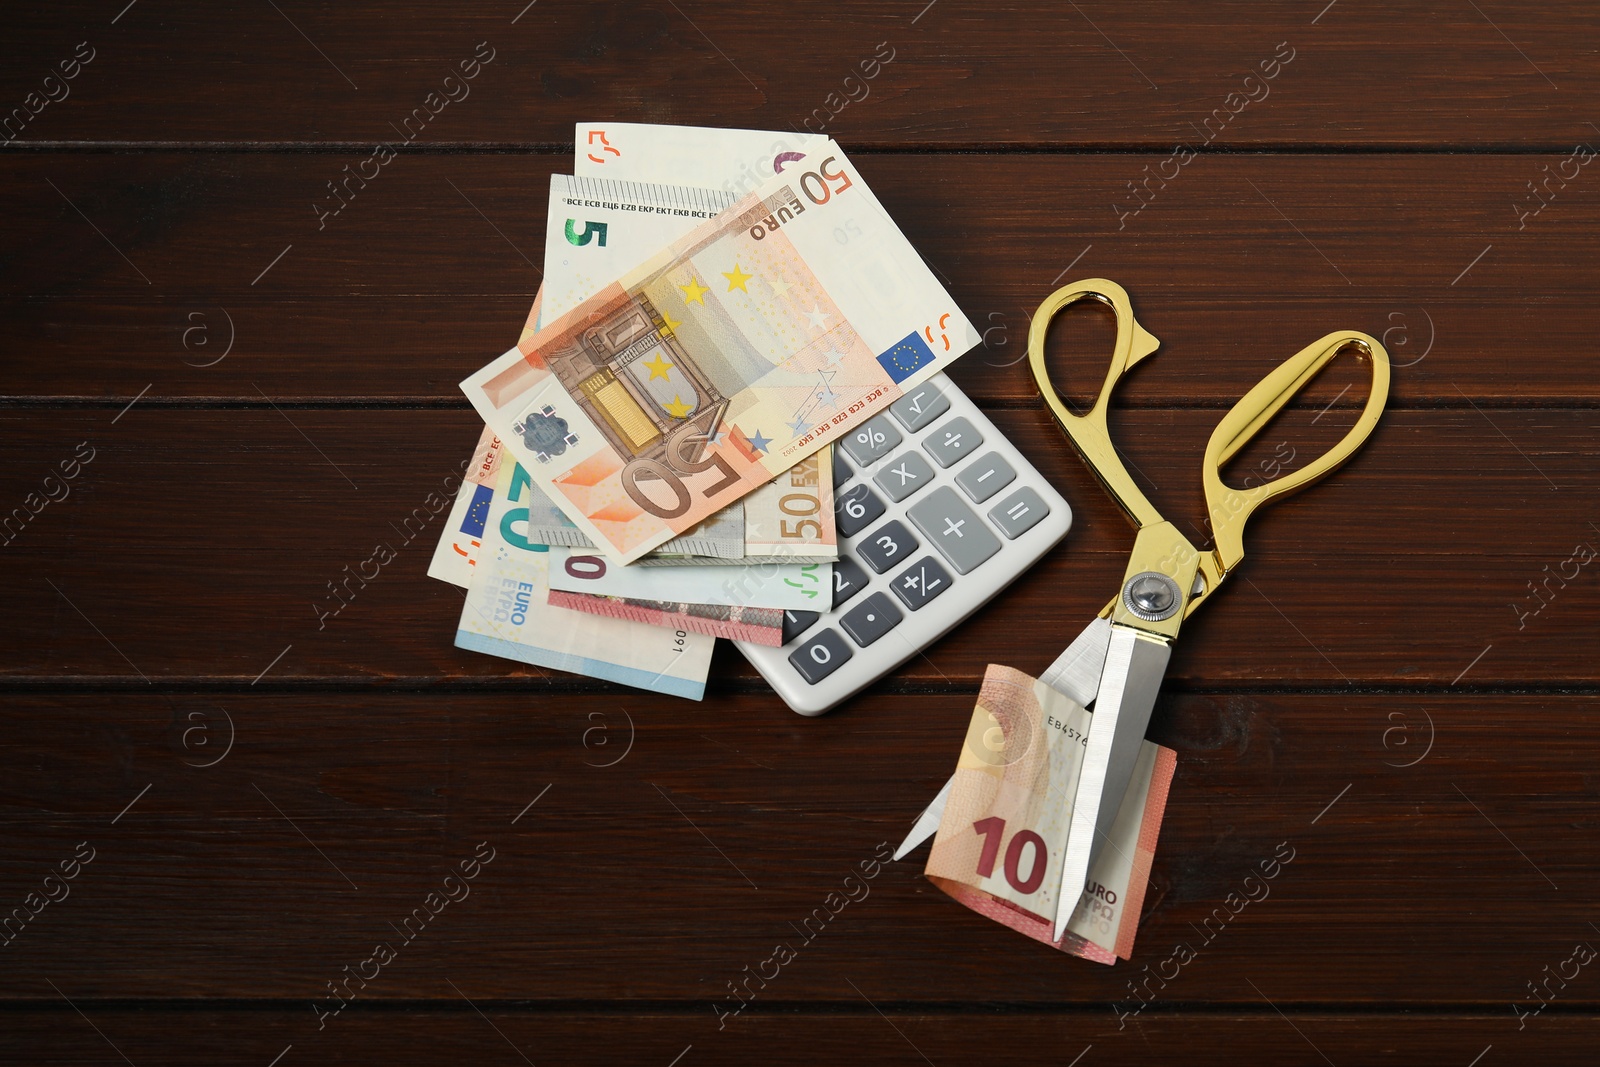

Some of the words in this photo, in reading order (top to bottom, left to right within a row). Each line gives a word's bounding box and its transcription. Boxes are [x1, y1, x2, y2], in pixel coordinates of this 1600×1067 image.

[800, 156, 853, 206] 50
[750, 198, 806, 241] EURO
[564, 218, 609, 248] 5
[848, 399, 866, 415] ECB
[831, 411, 849, 426] EZB
[798, 434, 815, 447] EKP
[815, 423, 831, 437] EKT
[491, 437, 501, 449] EC
[621, 423, 742, 519] 50
[779, 493, 823, 538] 50
[846, 498, 865, 518] 6
[876, 535, 898, 557] 3
[833, 571, 850, 592] 2
[510, 582, 533, 626] EURO
[810, 644, 831, 664] 0
[972, 816, 1048, 895] 10
[1085, 880, 1117, 904] URO
